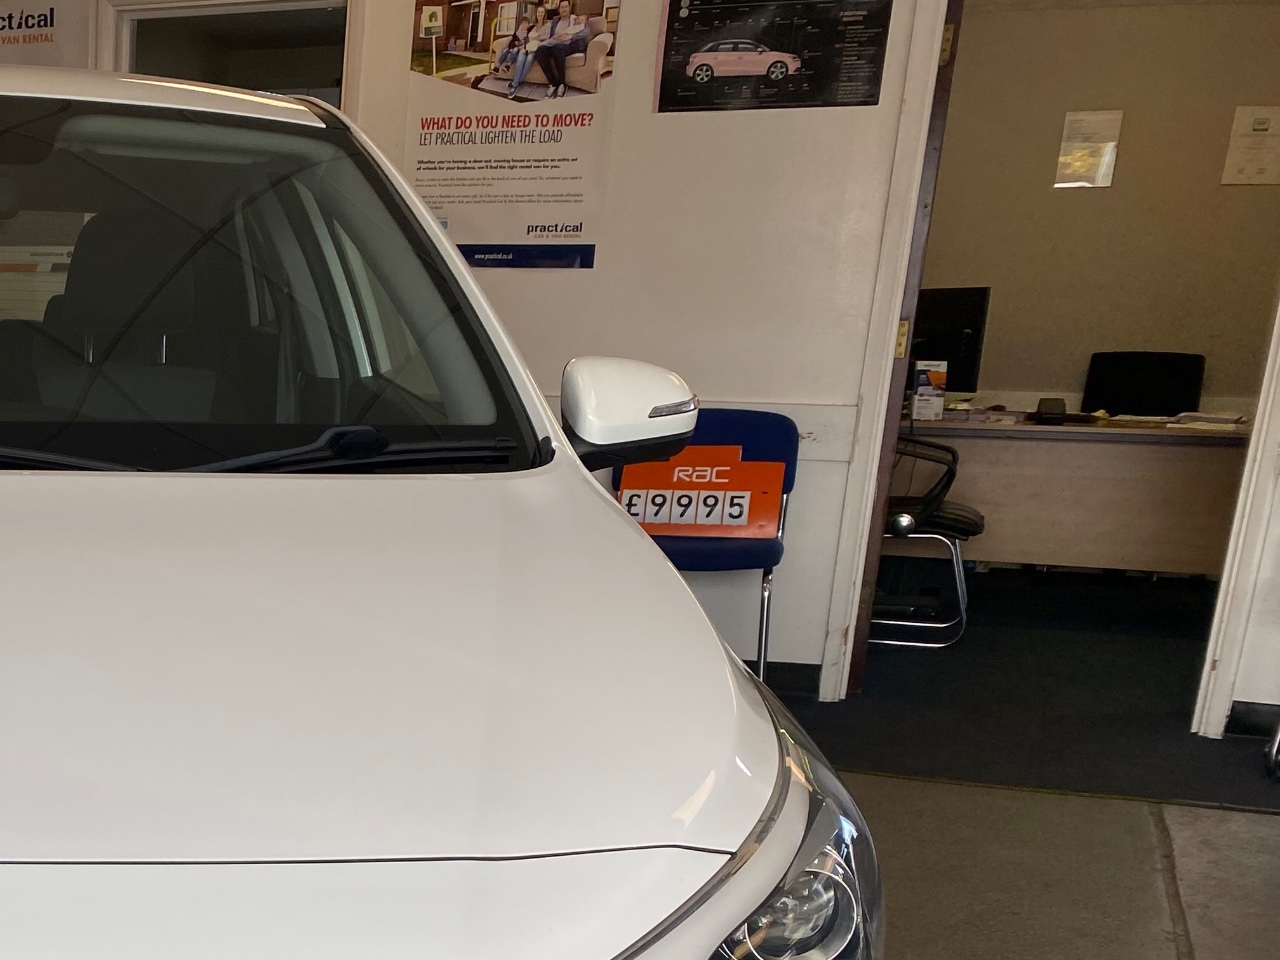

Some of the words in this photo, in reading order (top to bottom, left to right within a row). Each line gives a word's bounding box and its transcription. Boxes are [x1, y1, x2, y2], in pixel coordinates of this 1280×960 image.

[1, 35, 20, 45] VAN
[22, 33, 54, 44] RENTAL
[420, 116, 453, 131] WHAT
[455, 116, 472, 129] DO
[475, 115, 499, 129] YOU
[501, 114, 531, 128] NEED
[534, 114, 550, 128] TO
[552, 113, 594, 127] MOVE?
[419, 132, 433, 146] LET
[435, 131, 477, 145] PRACTICAL
[480, 130, 517, 144] LIGHTEN
[519, 130, 536, 143] THE
[538, 129, 563, 143] LOAD
[526, 222, 583, 235] practical
[625, 493, 745, 519] £9995
